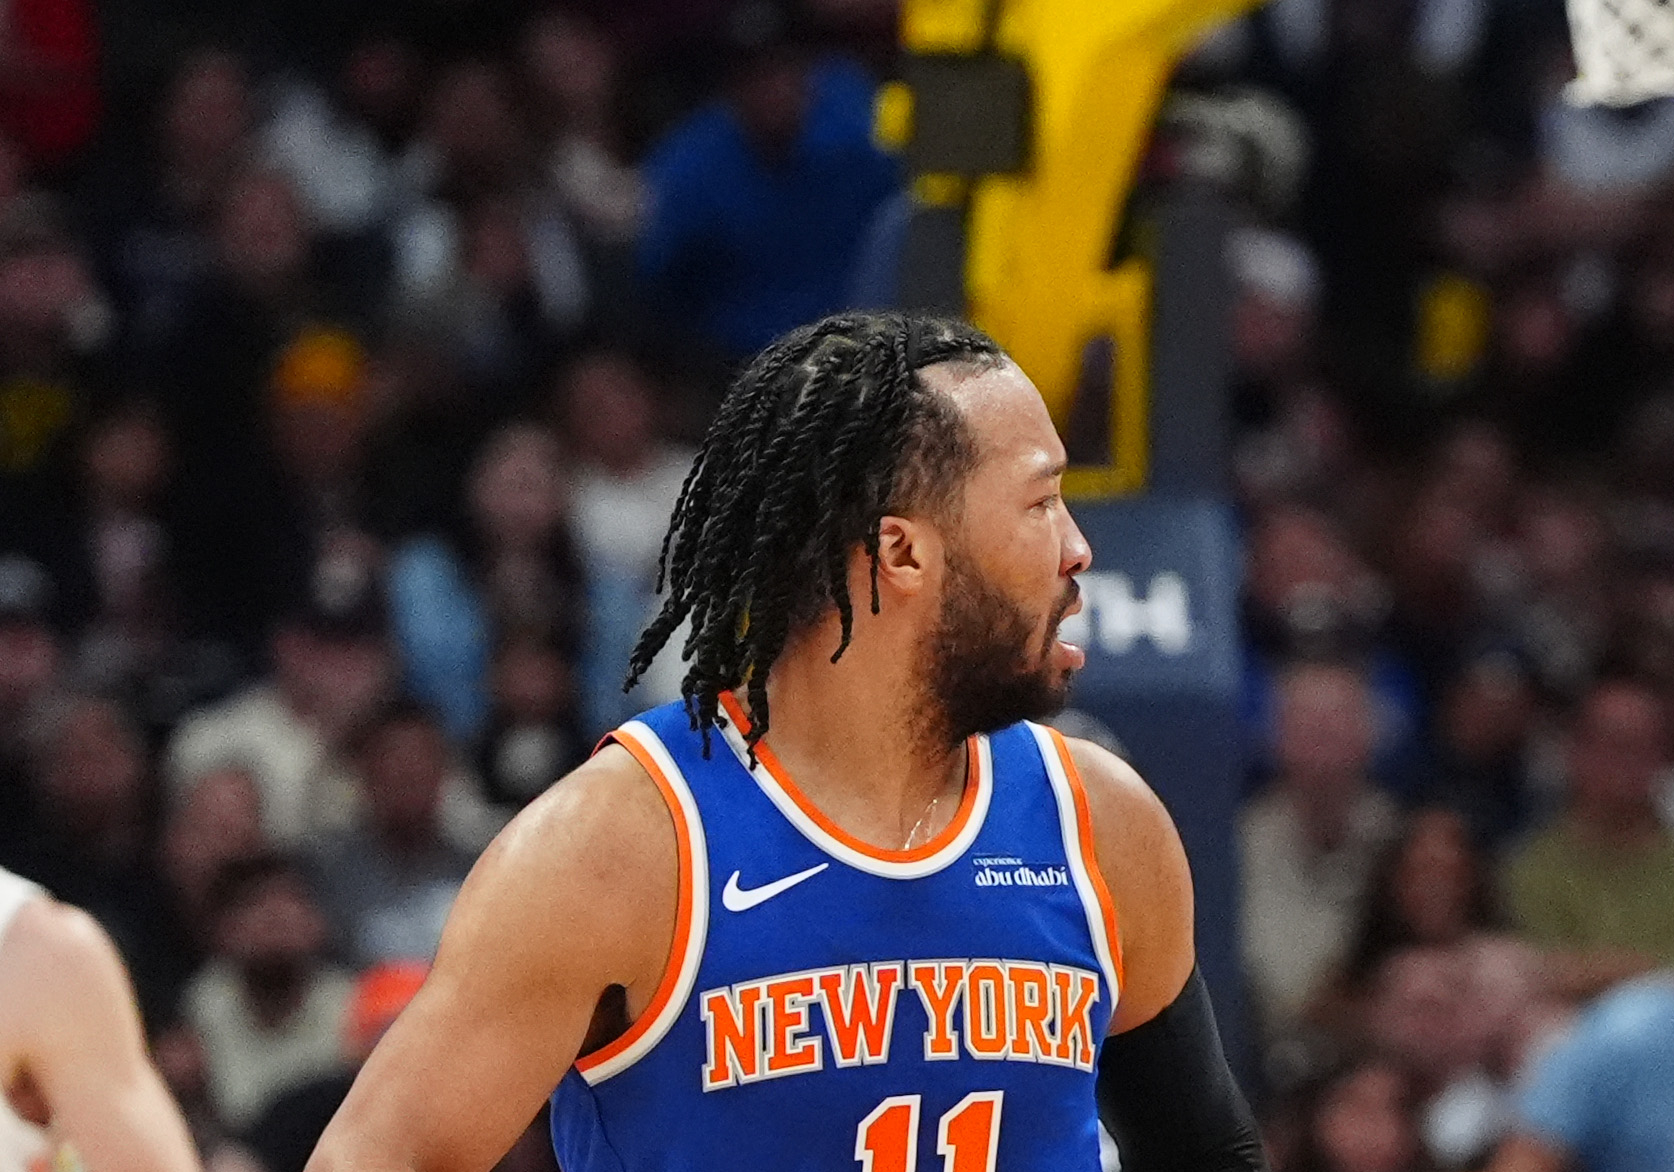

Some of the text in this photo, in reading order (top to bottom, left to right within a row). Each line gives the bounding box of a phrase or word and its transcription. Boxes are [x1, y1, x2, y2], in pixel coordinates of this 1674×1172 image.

[975, 866, 1068, 887] abu dhabi
[700, 958, 1099, 1093] NEW YORK
